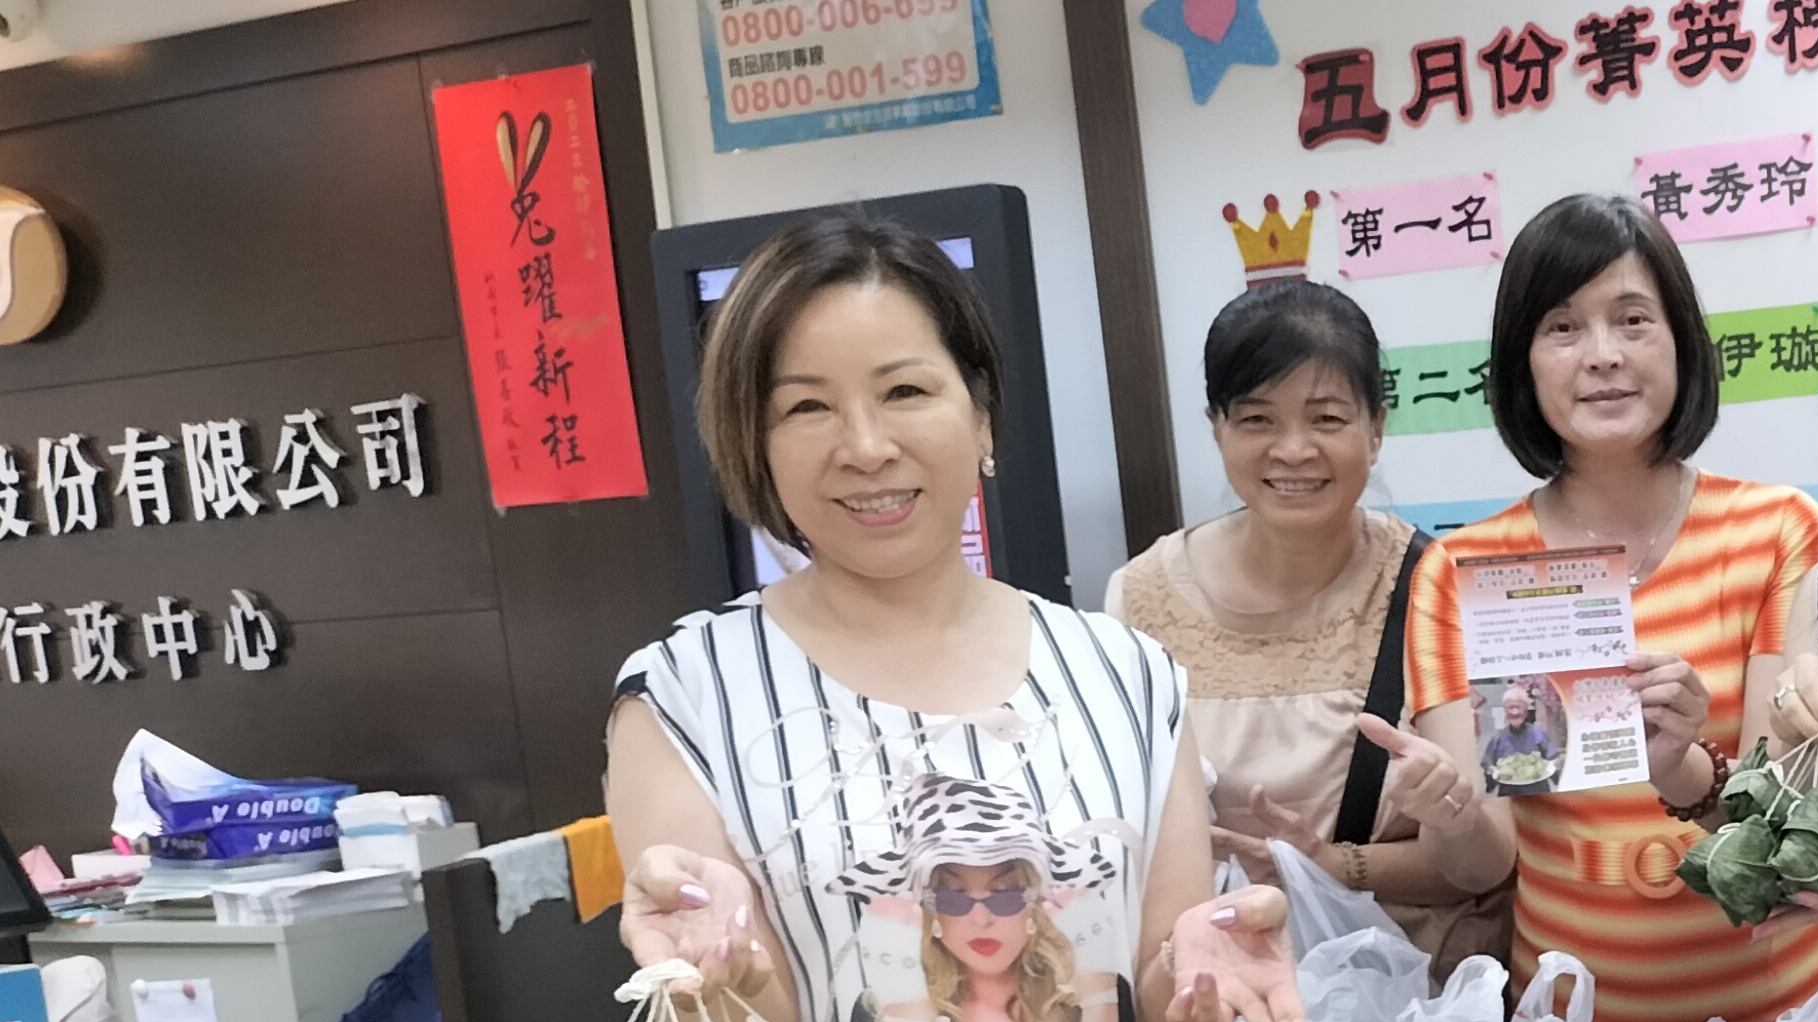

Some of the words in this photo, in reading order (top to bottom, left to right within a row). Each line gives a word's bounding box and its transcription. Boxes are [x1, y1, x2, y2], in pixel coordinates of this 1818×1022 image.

[731, 50, 967, 115] 0800-001-599
[1341, 195, 1494, 258] 第一名
[1641, 154, 1814, 222] 黃秀玲
[0, 589, 278, 684] 行政中心
[211, 803, 229, 823] A
[237, 797, 320, 819] Double
[258, 831, 273, 850] A
[278, 824, 335, 846] ouble
